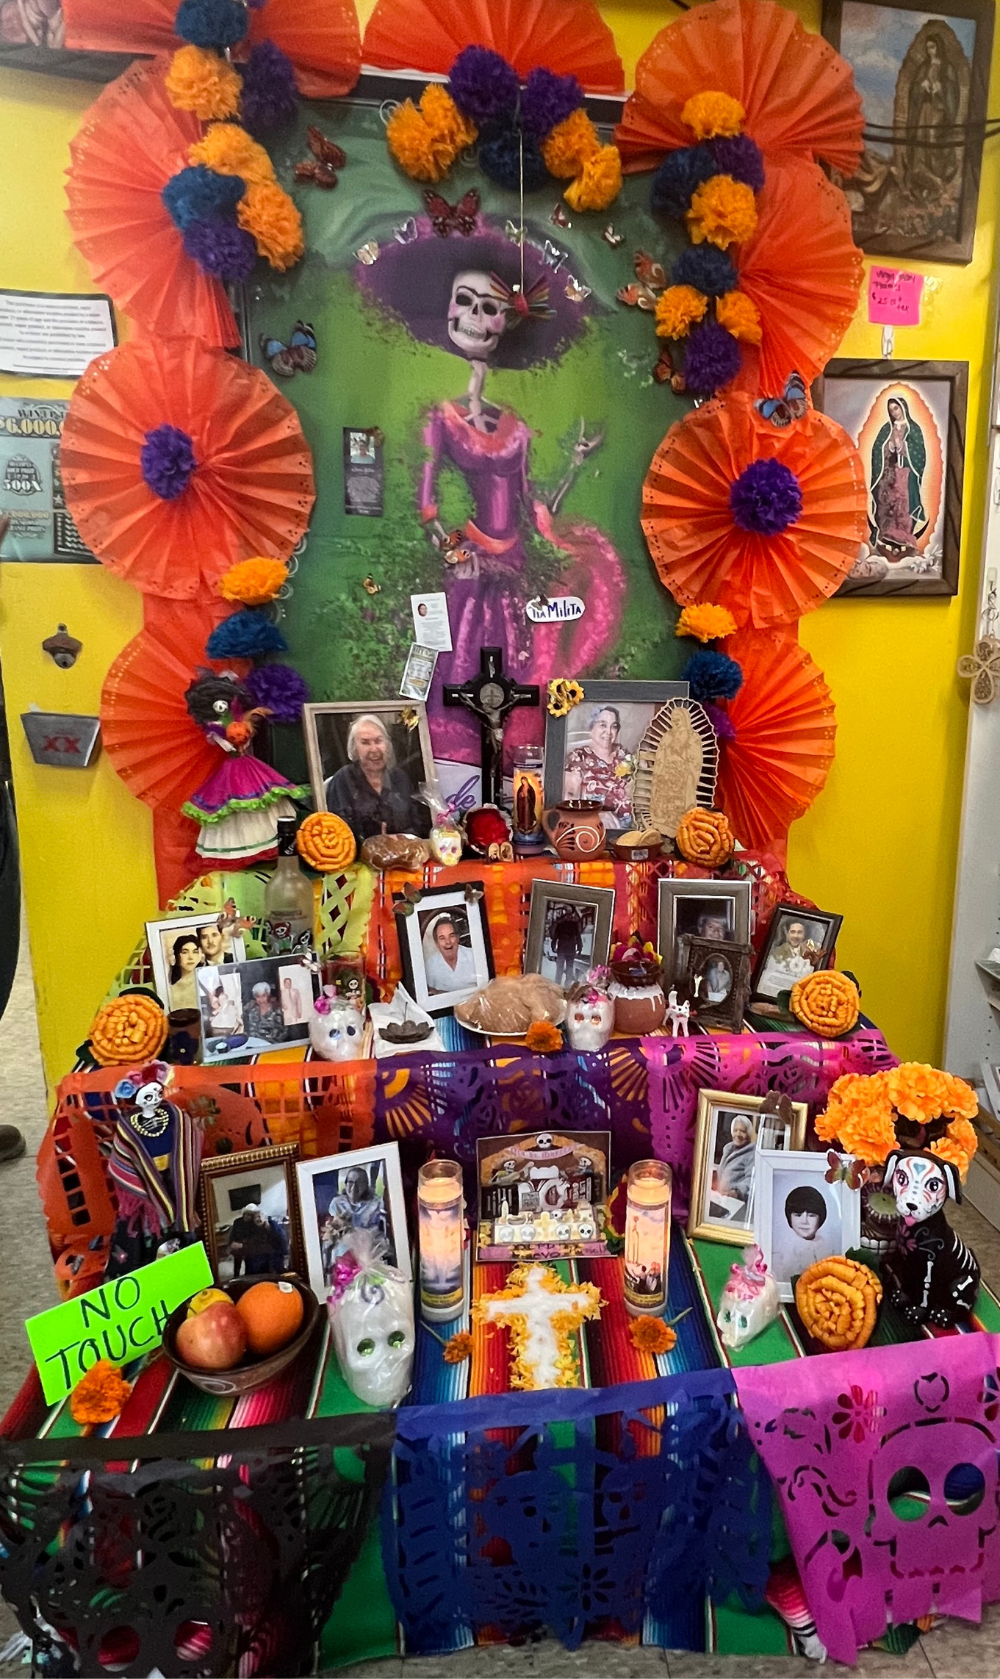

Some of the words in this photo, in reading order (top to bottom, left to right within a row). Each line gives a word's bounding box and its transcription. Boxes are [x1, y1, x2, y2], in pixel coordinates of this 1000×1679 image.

[42, 735, 82, 754] XX
[80, 1276, 141, 1329] NO
[45, 1299, 172, 1390] TOUCH
